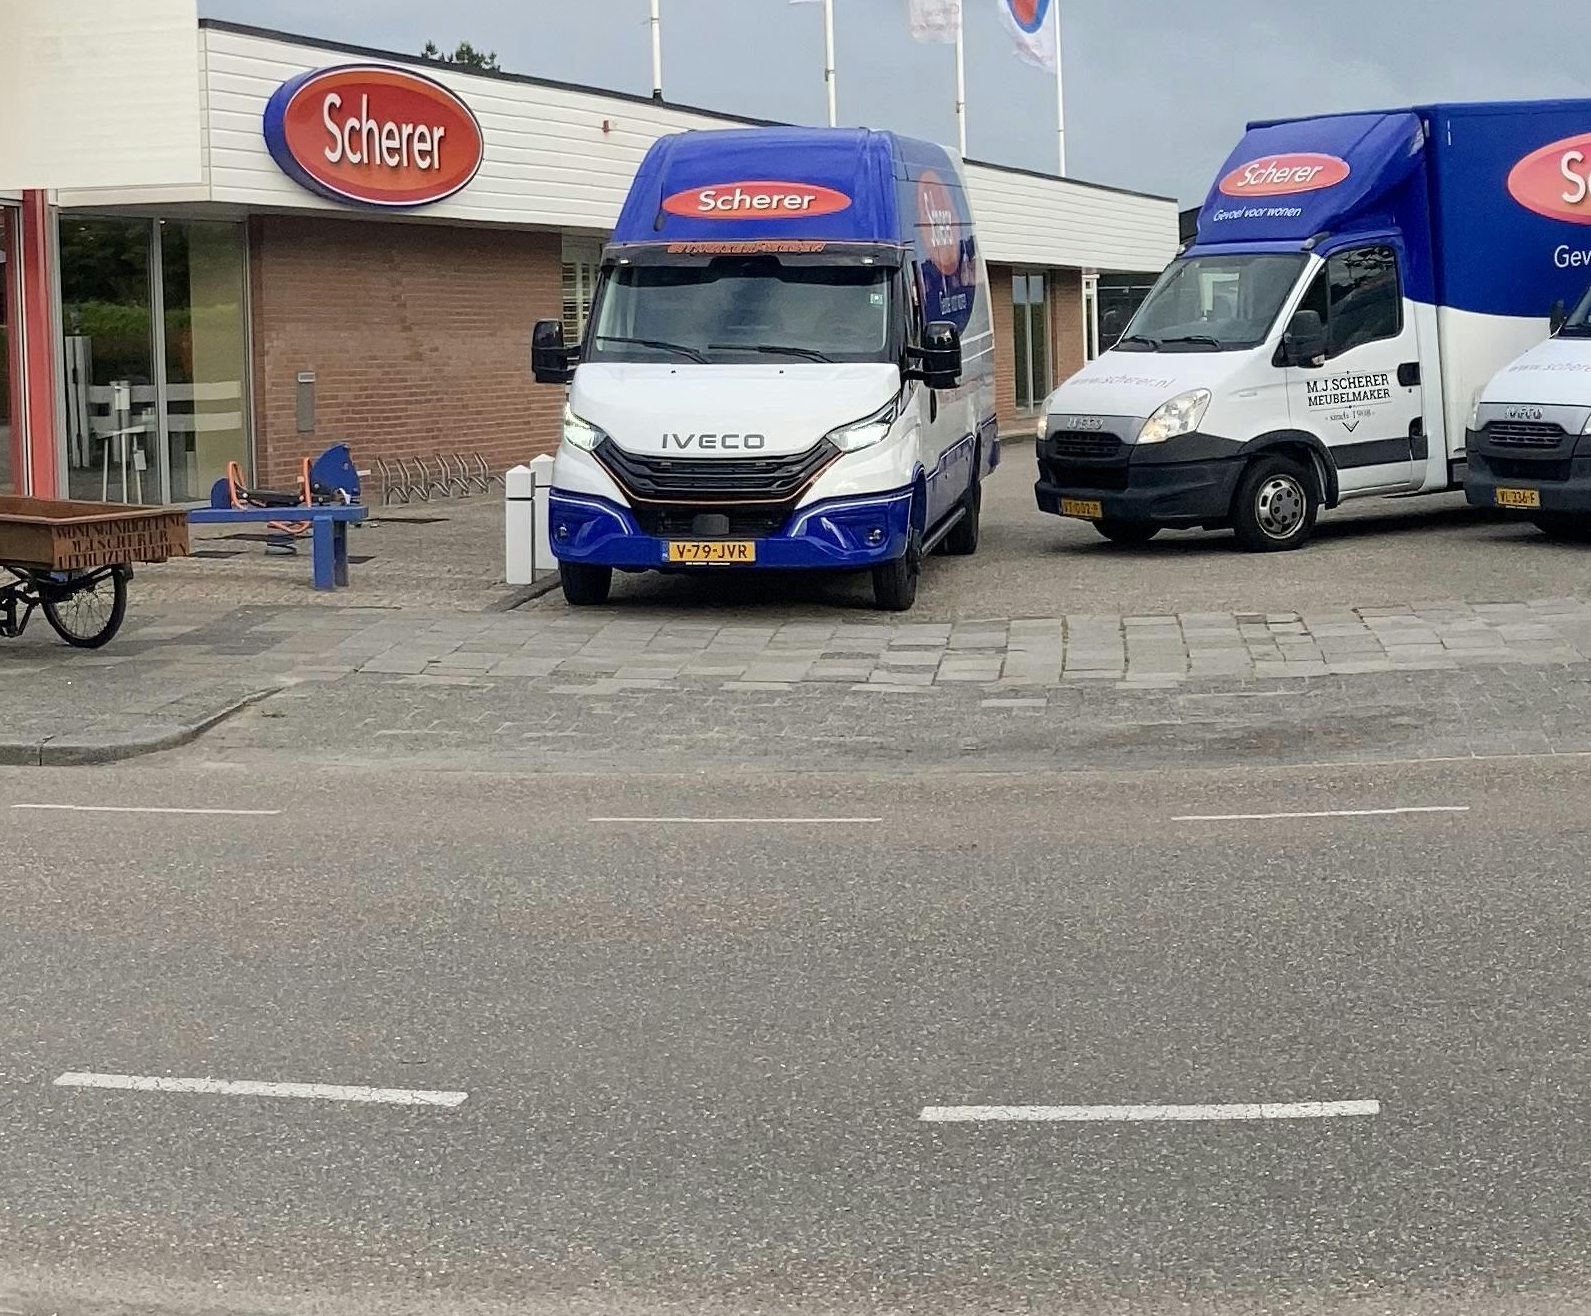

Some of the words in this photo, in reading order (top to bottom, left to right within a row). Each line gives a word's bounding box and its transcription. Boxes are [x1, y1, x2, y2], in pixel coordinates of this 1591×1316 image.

[323, 93, 445, 170] Scherer
[1237, 160, 1324, 187] Scherer
[698, 188, 816, 211] Scherer
[1214, 206, 1246, 221] Gevoel
[1244, 207, 1266, 218] voor
[1267, 207, 1302, 218] wonen
[1308, 388, 1390, 406] MEUBELMAKER
[662, 434, 765, 450] IVECO
[677, 544, 748, 559] V-79-JVR
